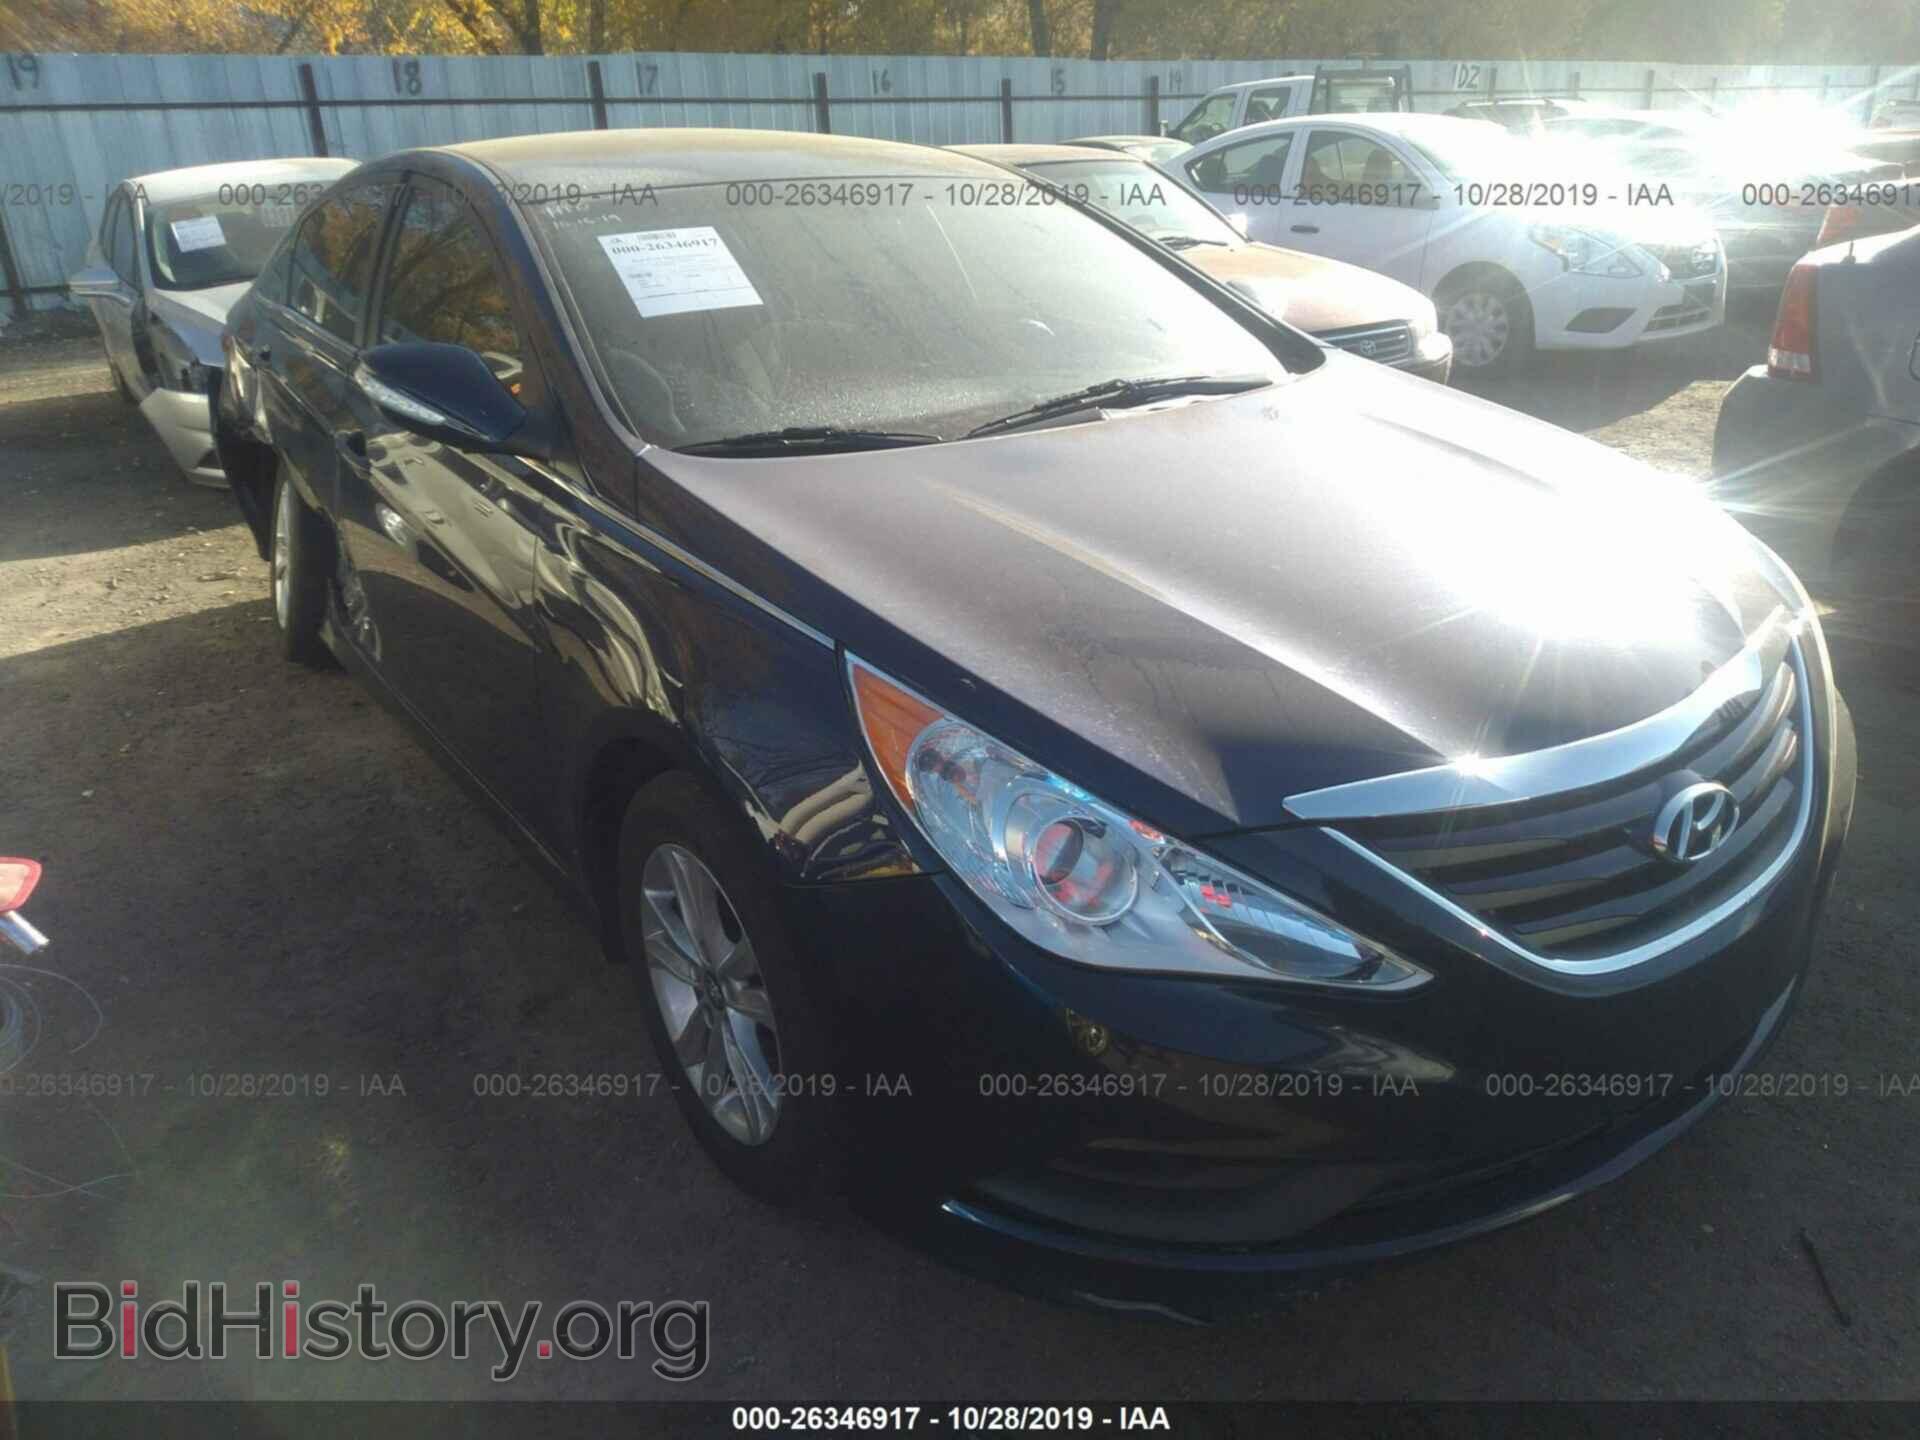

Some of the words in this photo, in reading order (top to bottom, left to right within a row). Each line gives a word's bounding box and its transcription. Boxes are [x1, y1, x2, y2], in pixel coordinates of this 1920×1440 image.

[6, 53, 40, 91] 19
[391, 58, 423, 94] 18
[635, 61, 658, 95] 17
[872, 68, 891, 95] 16
[1451, 62, 1481, 89] 102
[612, 237, 718, 255] 000-26346917
